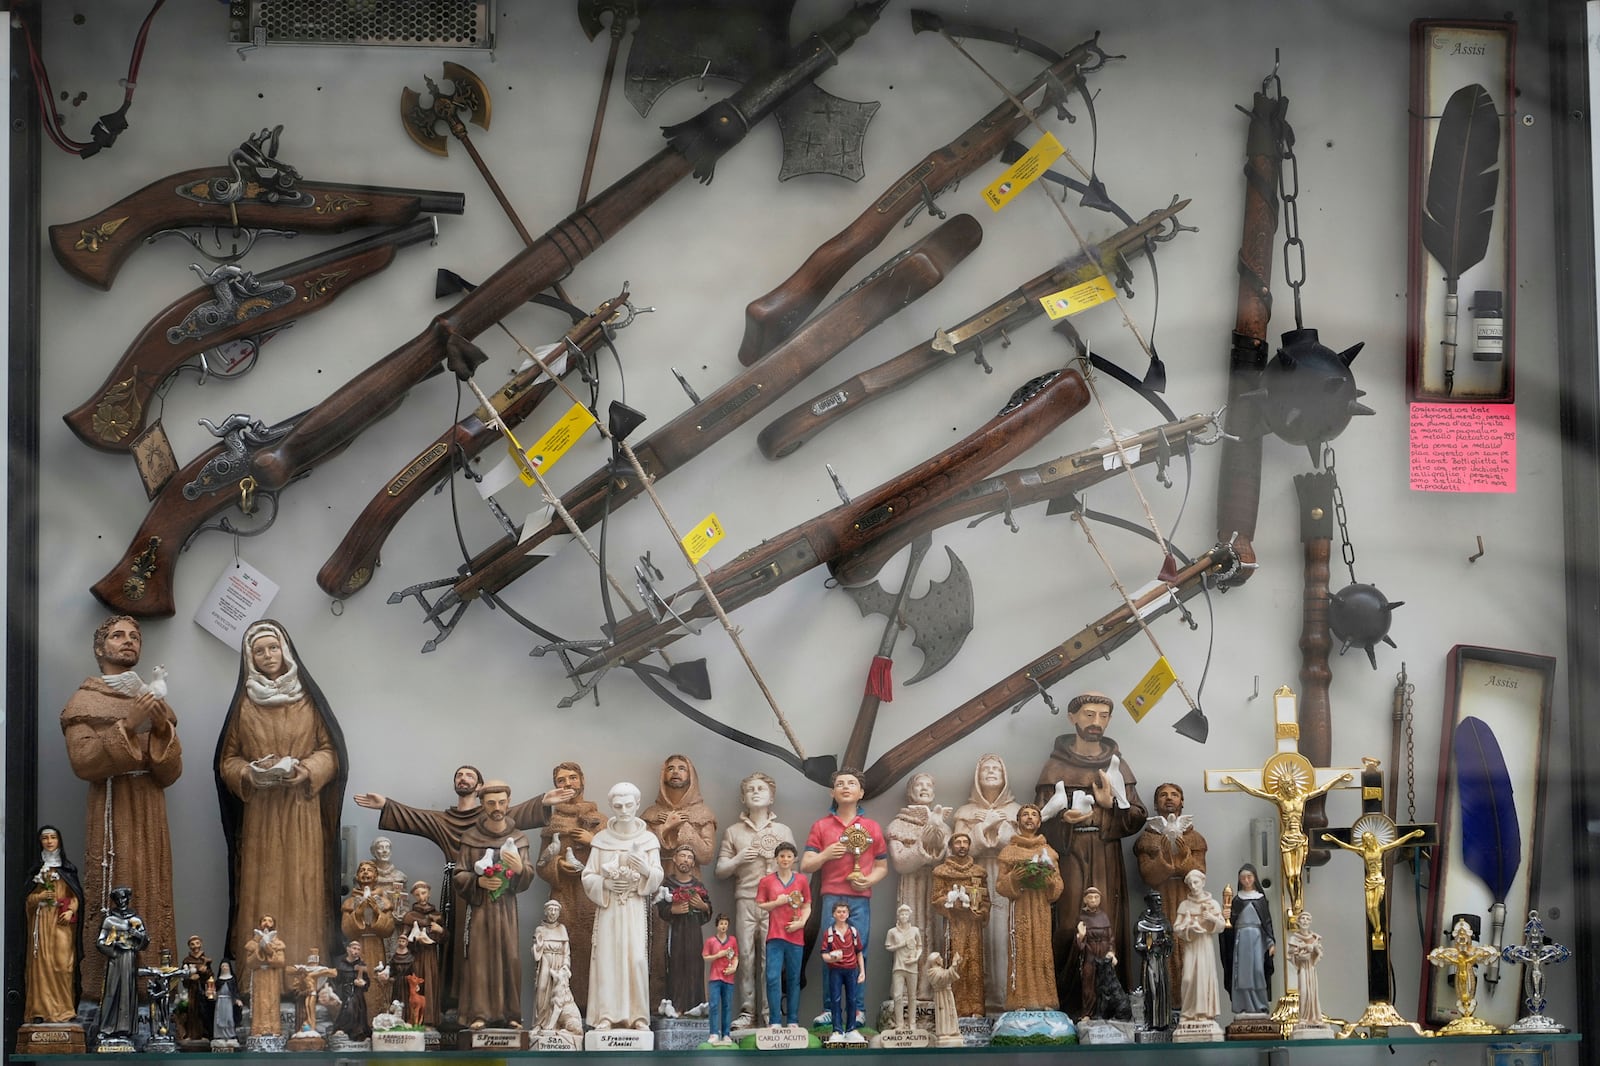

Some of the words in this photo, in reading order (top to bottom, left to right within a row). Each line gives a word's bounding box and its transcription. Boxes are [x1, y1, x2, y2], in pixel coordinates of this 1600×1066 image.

[1450, 42, 1486, 56] Assisi
[1412, 406, 1451, 414] Confezione
[1484, 676, 1519, 688] Assisi
